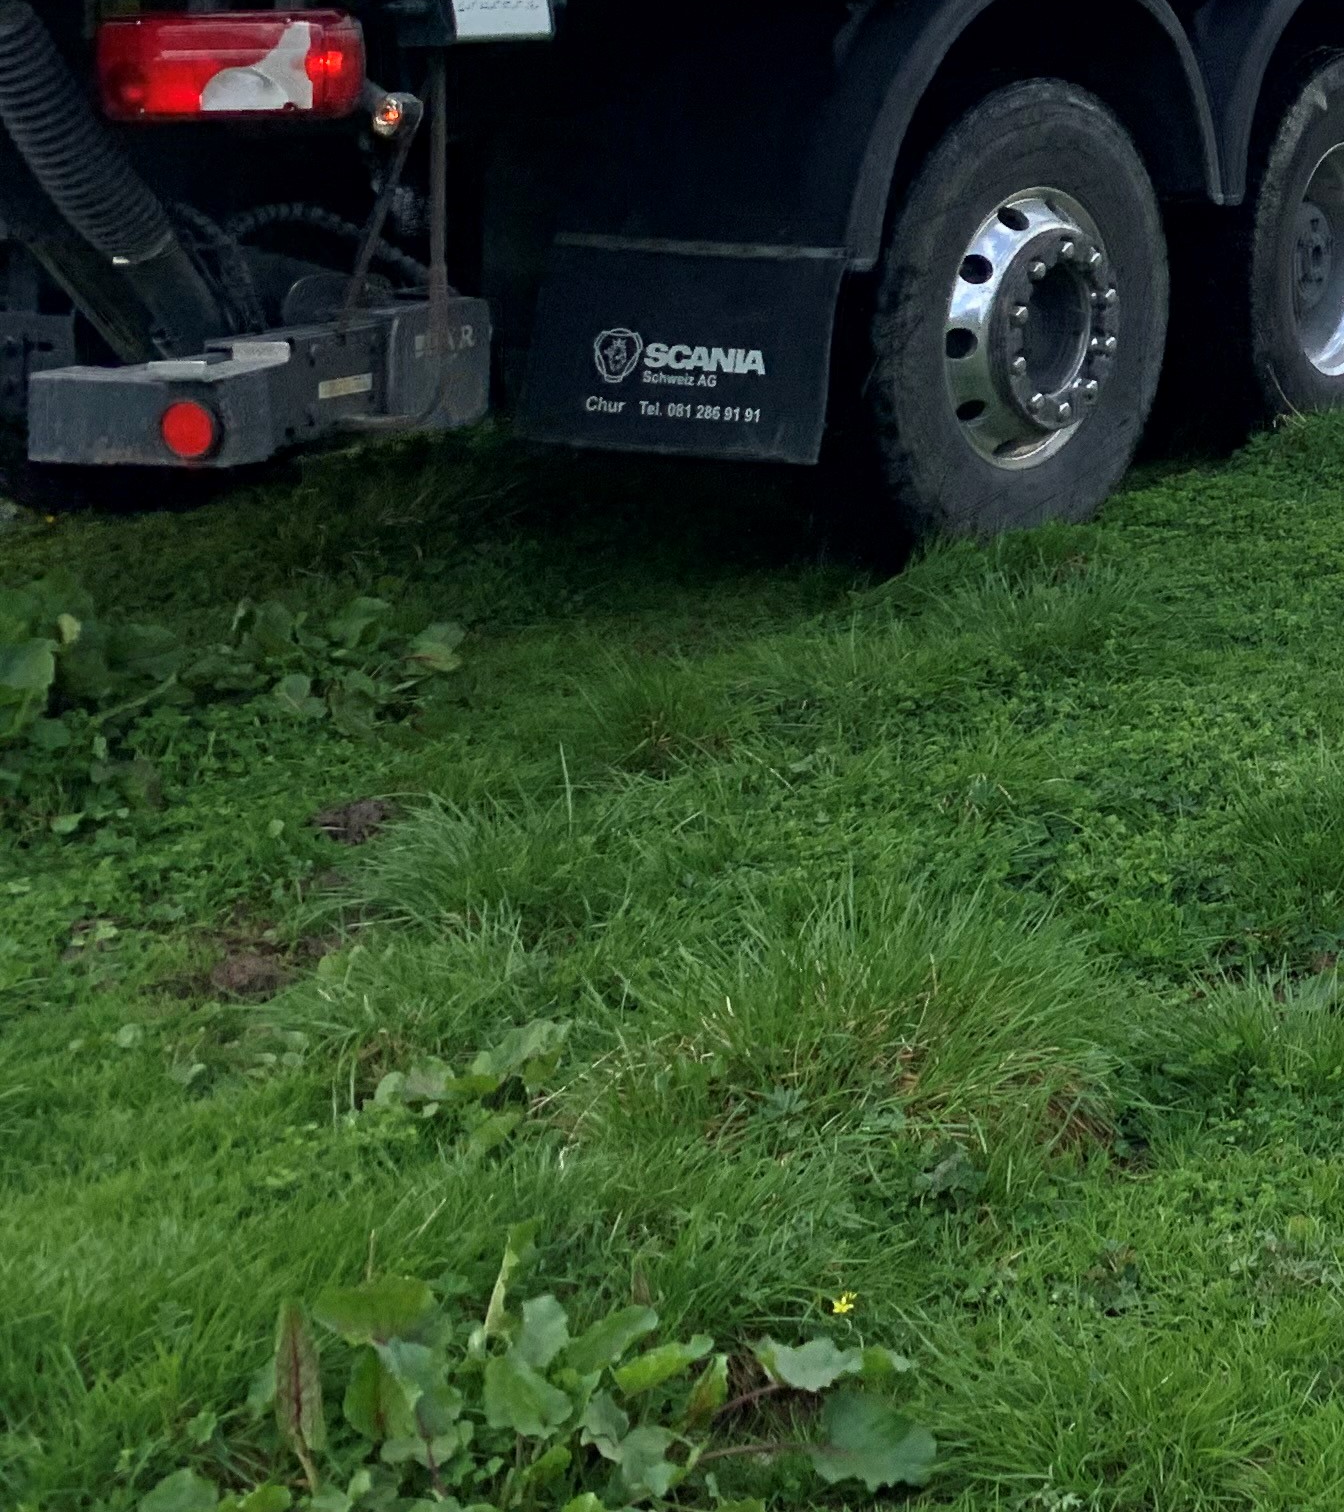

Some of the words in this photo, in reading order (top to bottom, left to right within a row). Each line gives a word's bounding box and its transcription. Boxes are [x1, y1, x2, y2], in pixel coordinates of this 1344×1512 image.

[643, 342, 766, 375] SCANIA
[642, 370, 695, 386] Schweiz
[697, 374, 718, 388] AG
[585, 395, 626, 414] Chur
[639, 400, 663, 417] Tel.
[667, 403, 692, 419] 081
[695, 405, 722, 421] 286
[724, 407, 741, 421] 91
[744, 407, 762, 423] 91
